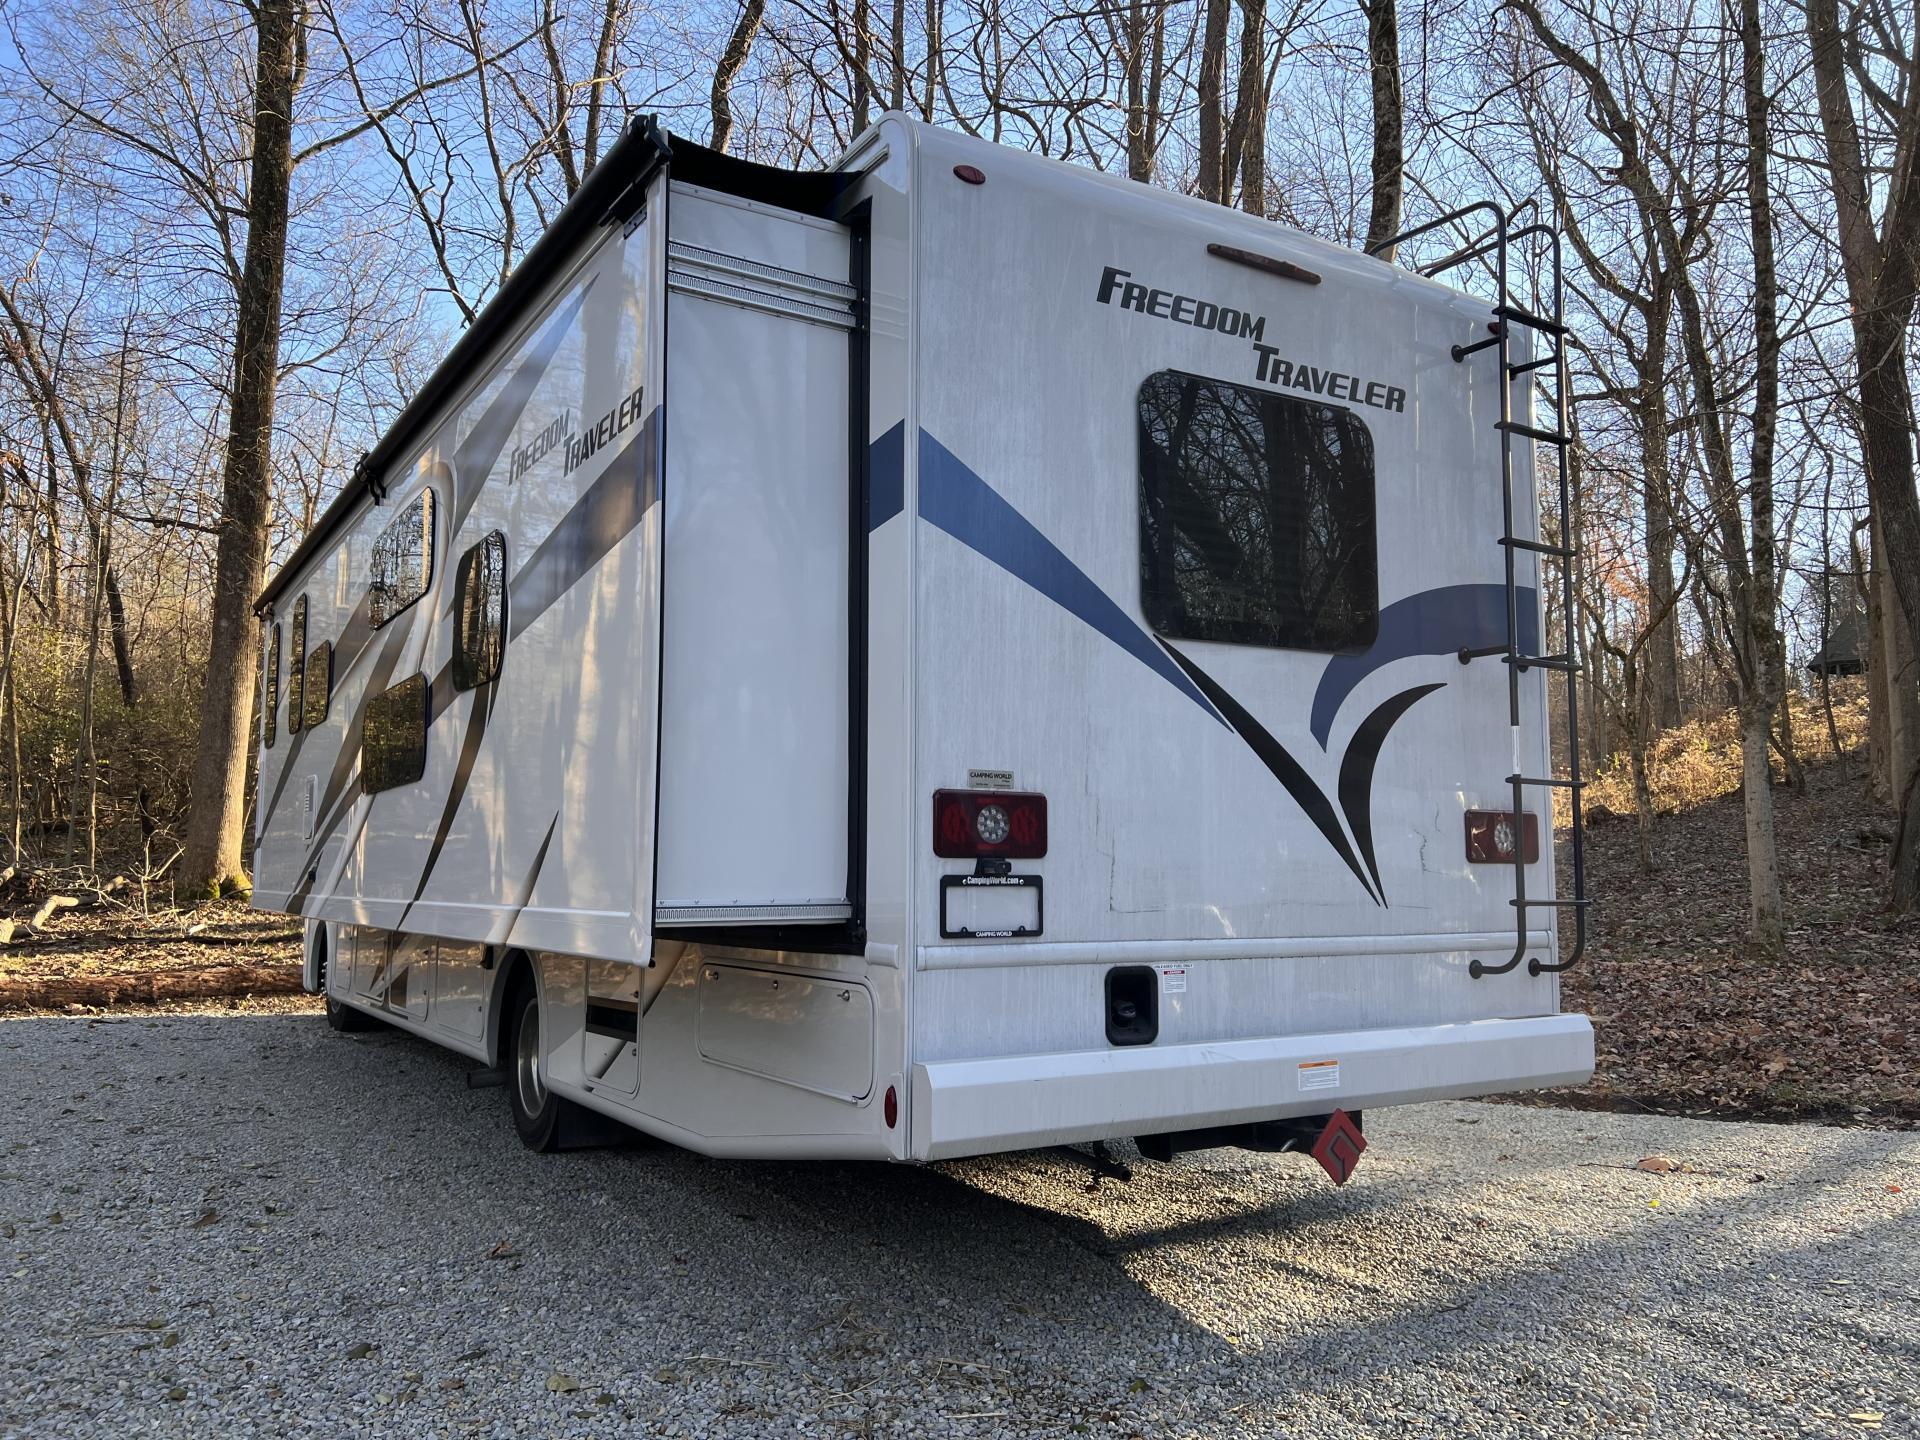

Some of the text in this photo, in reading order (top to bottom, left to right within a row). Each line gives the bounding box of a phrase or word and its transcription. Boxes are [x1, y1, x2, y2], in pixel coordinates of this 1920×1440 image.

[1096, 266, 1266, 342] FREEDOM
[1253, 343, 1407, 413] TRAVELER
[509, 407, 570, 486] FREEDOM
[564, 385, 644, 478] TRAVELER
[967, 876, 1019, 885] CampingWorld.com
